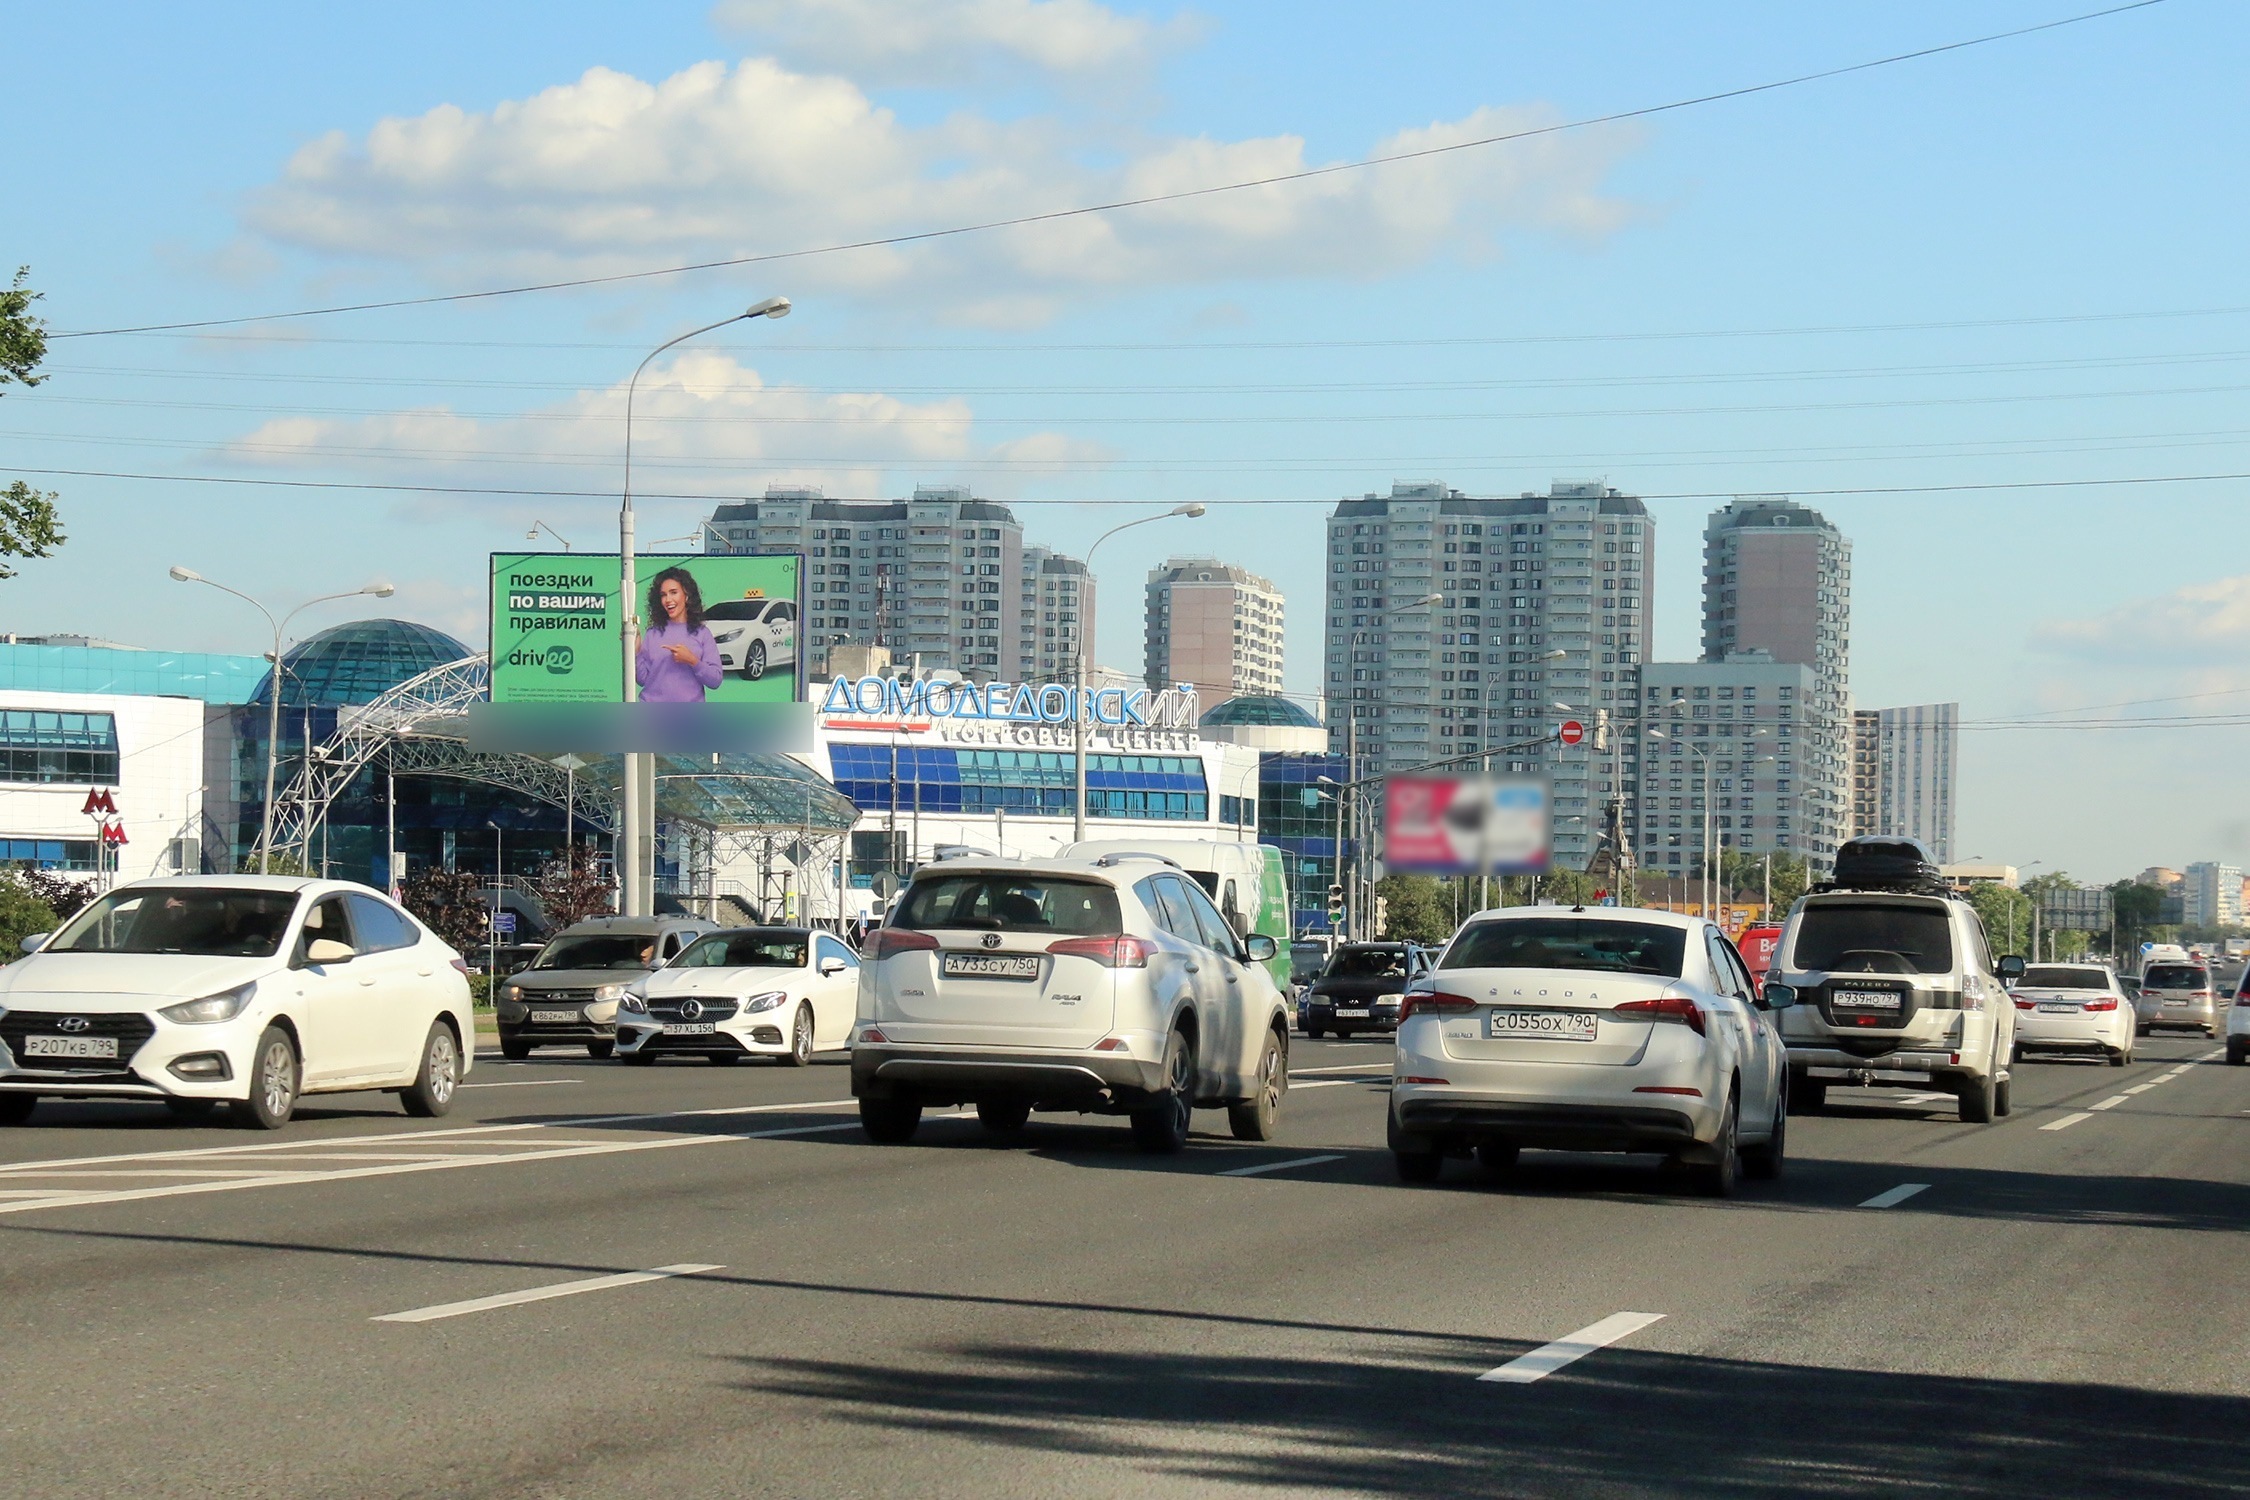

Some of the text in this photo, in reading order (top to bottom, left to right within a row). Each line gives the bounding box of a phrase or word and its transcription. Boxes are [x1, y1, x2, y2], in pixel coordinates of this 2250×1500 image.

[510, 574, 593, 589] поездки
[510, 595, 605, 609] по вашим
[510, 617, 606, 633] правилам
[508, 646, 573, 674] drivee
[821, 674, 1199, 730] ДОМОДЕДОВСКИЙ
[1112, 729, 1201, 751] ЦЕНТР
[673, 1024, 713, 1033] 37 XL 156
